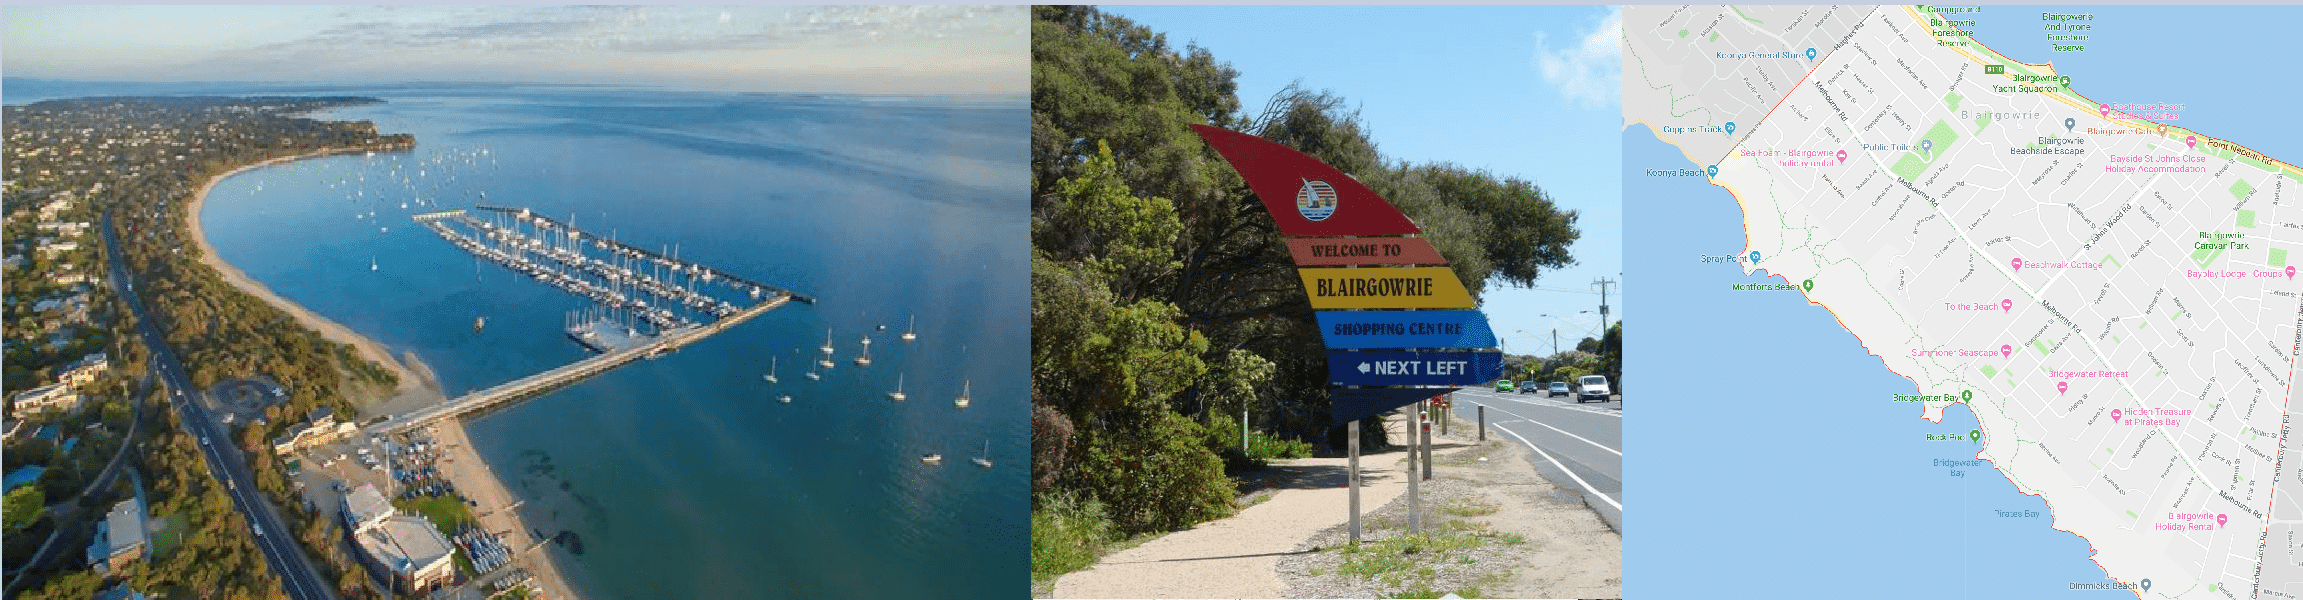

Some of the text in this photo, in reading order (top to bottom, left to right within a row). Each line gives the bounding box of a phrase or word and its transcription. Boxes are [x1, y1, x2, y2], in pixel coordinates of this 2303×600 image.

[1931, 19, 1976, 28] Blargowrie
[2063, 23, 2091, 32] Tyrone
[2012, 74, 2058, 83] Blairgowrie
[2019, 85, 2058, 93] Squadron
[1815, 81, 1848, 122] Melbourne Rd
[2113, 102, 2185, 111] Boathouse Resort
[1962, 111, 2040, 121] Blairgowrie
[2039, 137, 2085, 146] Blairgowrie
[1741, 149, 1756, 157] Sea
[1758, 149, 1781, 157] Foam
[2010, 147, 2085, 157] Beachside Escape
[2208, 138, 2228, 151] Point
[2261, 156, 2273, 166] Rd
[2110, 154, 2206, 164] Bayside St Johns Close
[1646, 169, 1677, 178] Koonya
[2105, 165, 2206, 174] Holiday Accommodation
[1897, 176, 1930, 201] Melbourne
[1929, 197, 1939, 207] Rd
[2121, 203, 2132, 215] Rd
[2199, 231, 2245, 240] Blargowrie
[1310, 244, 1402, 257] WELCOME TO
[2230, 242, 2250, 250] Park
[1700, 254, 1748, 264] Spray Pont
[2024, 260, 2103, 271] Beachwalk Cottage
[1316, 277, 1433, 297] BLAIRGOWRIE
[1732, 283, 1800, 291] Montforts Beach
[1944, 302, 1999, 311] To the Beach
[2042, 299, 2072, 327] Melbourne
[1334, 322, 1463, 336] SHOPPING CENTRE
[1958, 349, 1999, 358] Seascape
[1375, 360, 1468, 376] NEXT LEFT
[2048, 370, 2129, 379] Bridgewater Retreat
[1893, 393, 1959, 403] Bridgewater Bay
[2155, 407, 2192, 416] Treasure
[2124, 418, 2181, 427] at Pirates Bay
[1933, 459, 1982, 469] Bridgewater
[1950, 470, 1966, 479] Bay
[2219, 489, 2253, 514] Melbourne
[2252, 509, 2262, 519] Rd
[2024, 509, 2040, 519] Bay
[2168, 512, 2214, 521] Bairgowrie
[2155, 522, 2214, 532] Holiday Rental
[2069, 582, 2138, 590] Dimmicks Beach
